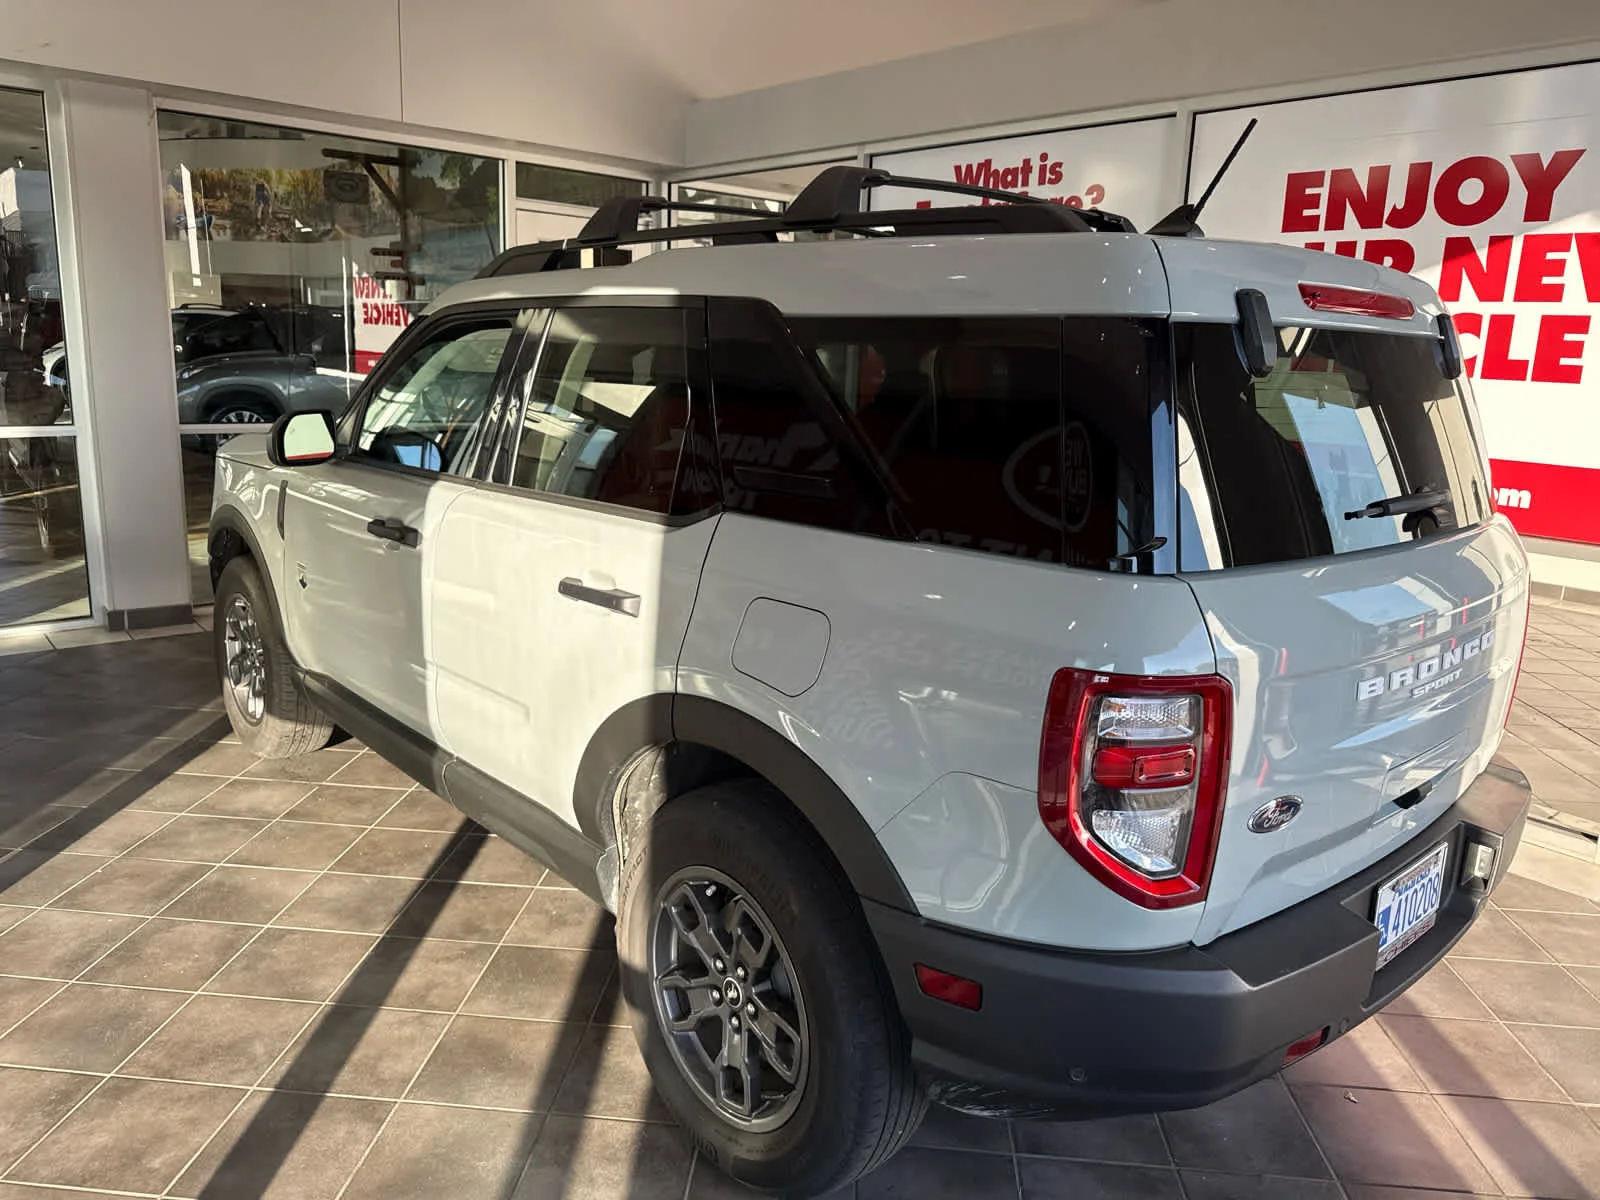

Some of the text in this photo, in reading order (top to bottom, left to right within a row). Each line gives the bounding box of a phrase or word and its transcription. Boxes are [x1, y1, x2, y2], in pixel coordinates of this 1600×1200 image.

[954, 152, 1064, 190] What is
[1281, 149, 1587, 233] ENJOY
[1438, 232, 1600, 303] NE
[1356, 628, 1495, 701] BRONCO
[1411, 667, 1463, 698] SPORT
[1391, 871, 1440, 937] 410208
